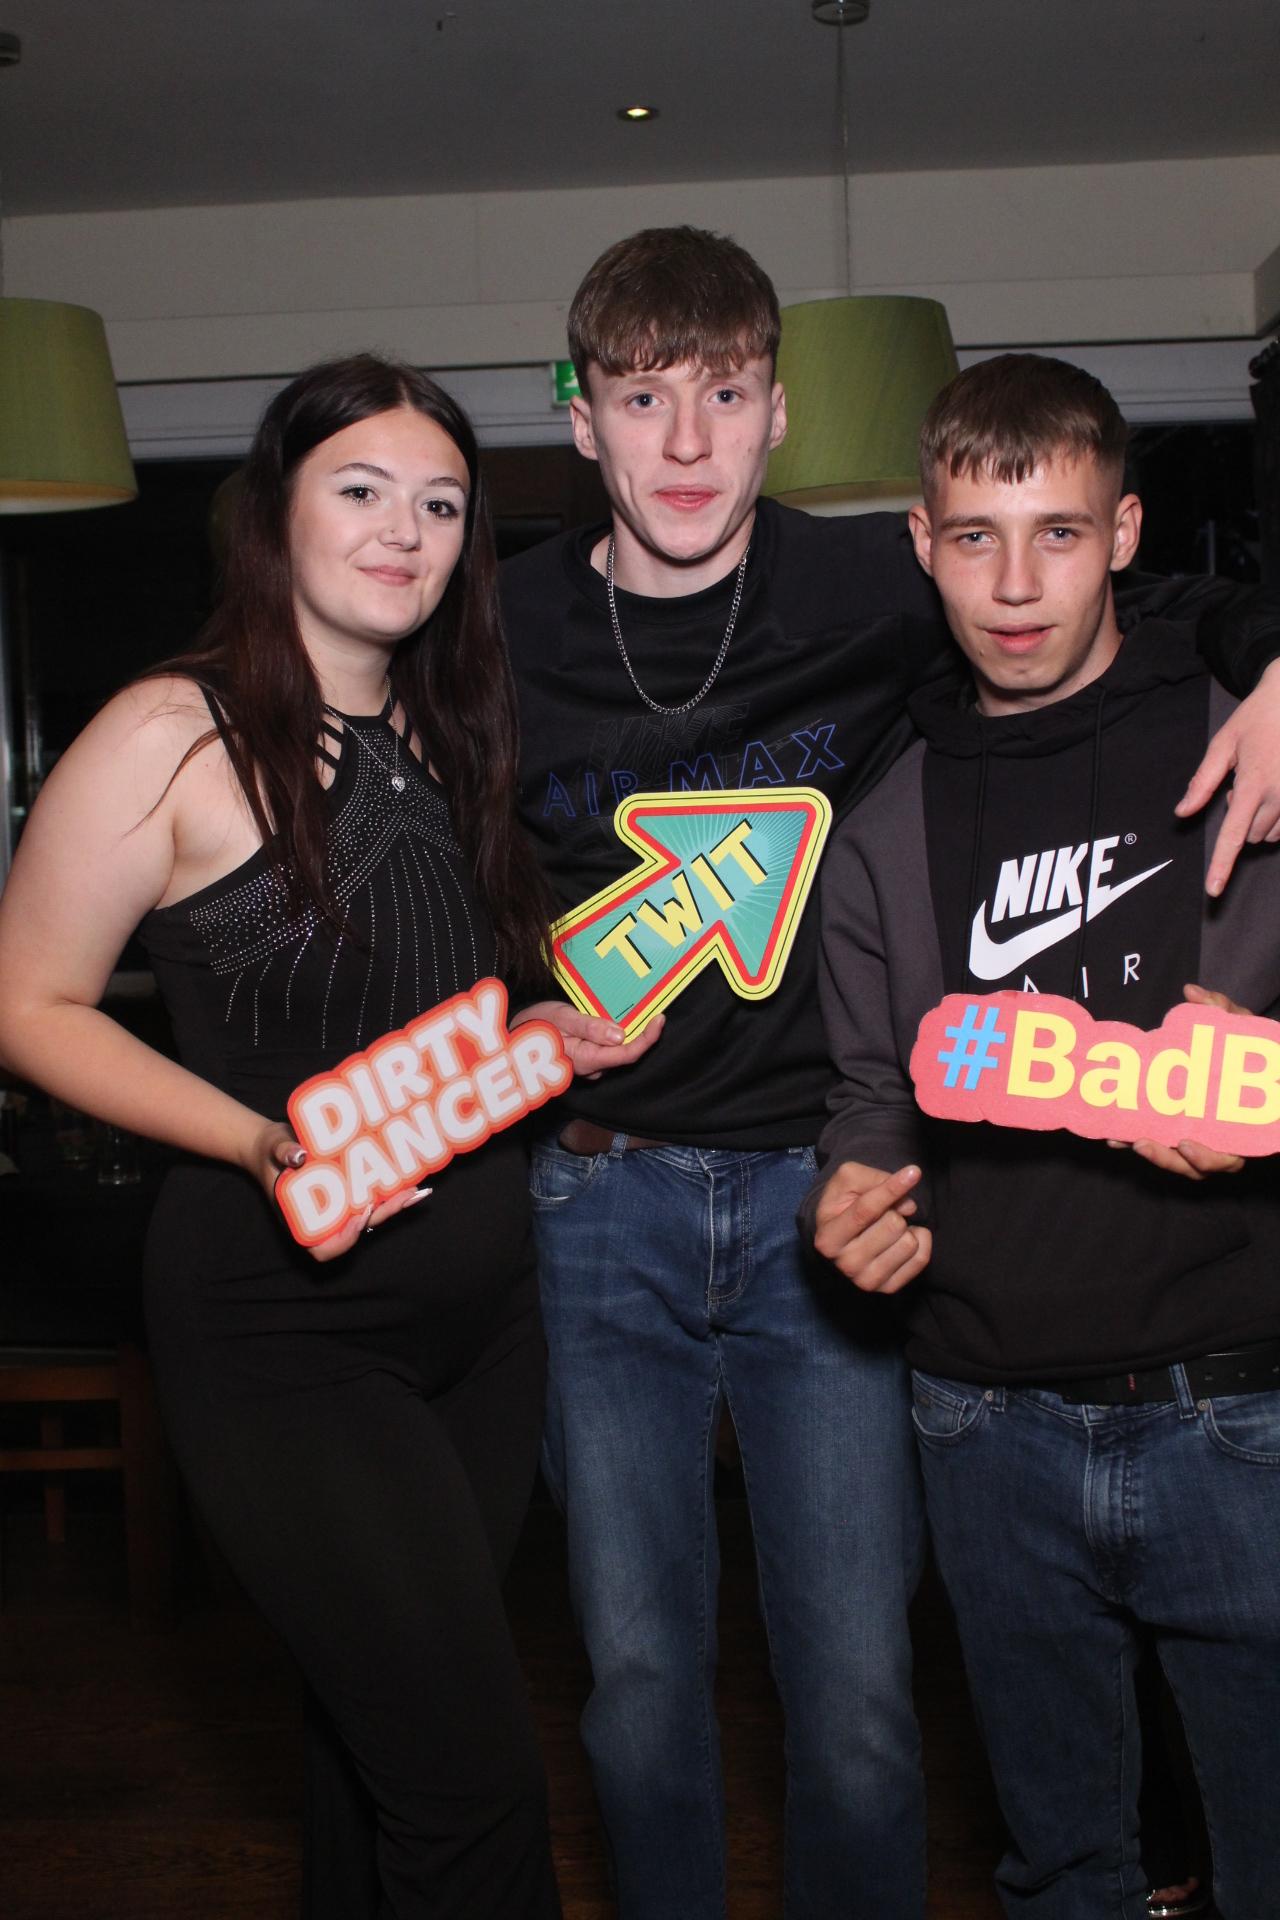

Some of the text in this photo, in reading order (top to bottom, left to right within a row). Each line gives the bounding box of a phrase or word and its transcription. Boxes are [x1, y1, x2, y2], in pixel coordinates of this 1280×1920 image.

[543, 723, 846, 817] AIR MAX
[594, 818, 768, 979] TWIT
[289, 1034, 565, 1231] DANCER
[302, 990, 499, 1152] DIRTY
[938, 1004, 1280, 1125] #BadB
